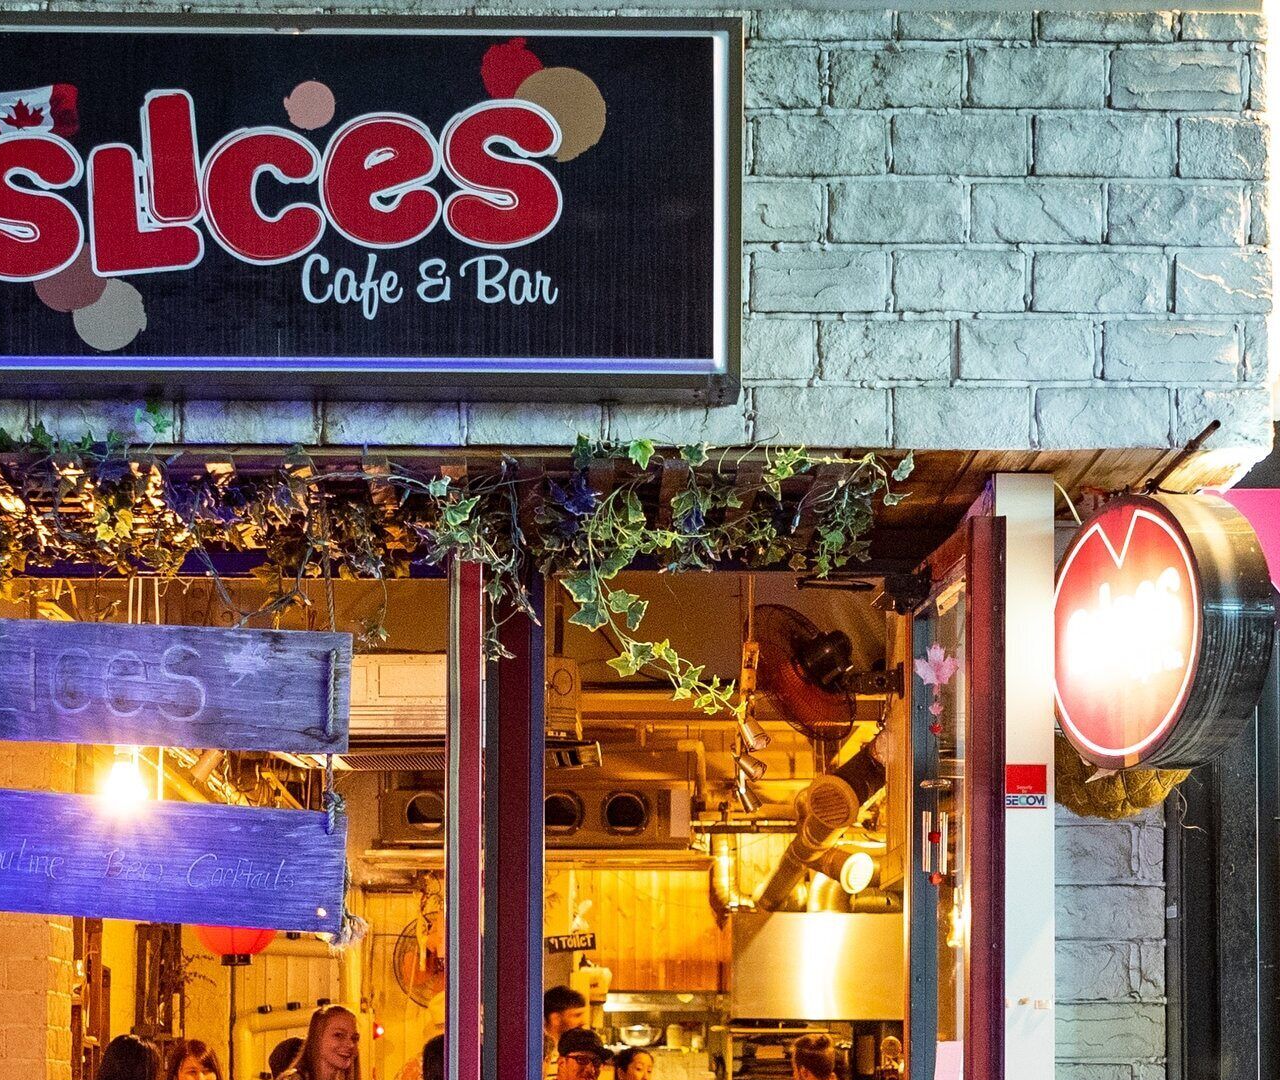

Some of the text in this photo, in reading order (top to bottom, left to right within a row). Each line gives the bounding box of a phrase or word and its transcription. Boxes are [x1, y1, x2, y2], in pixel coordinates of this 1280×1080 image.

[301, 254, 558, 320] Cafe & Bar
[1006, 796, 1045, 805] SECOM
